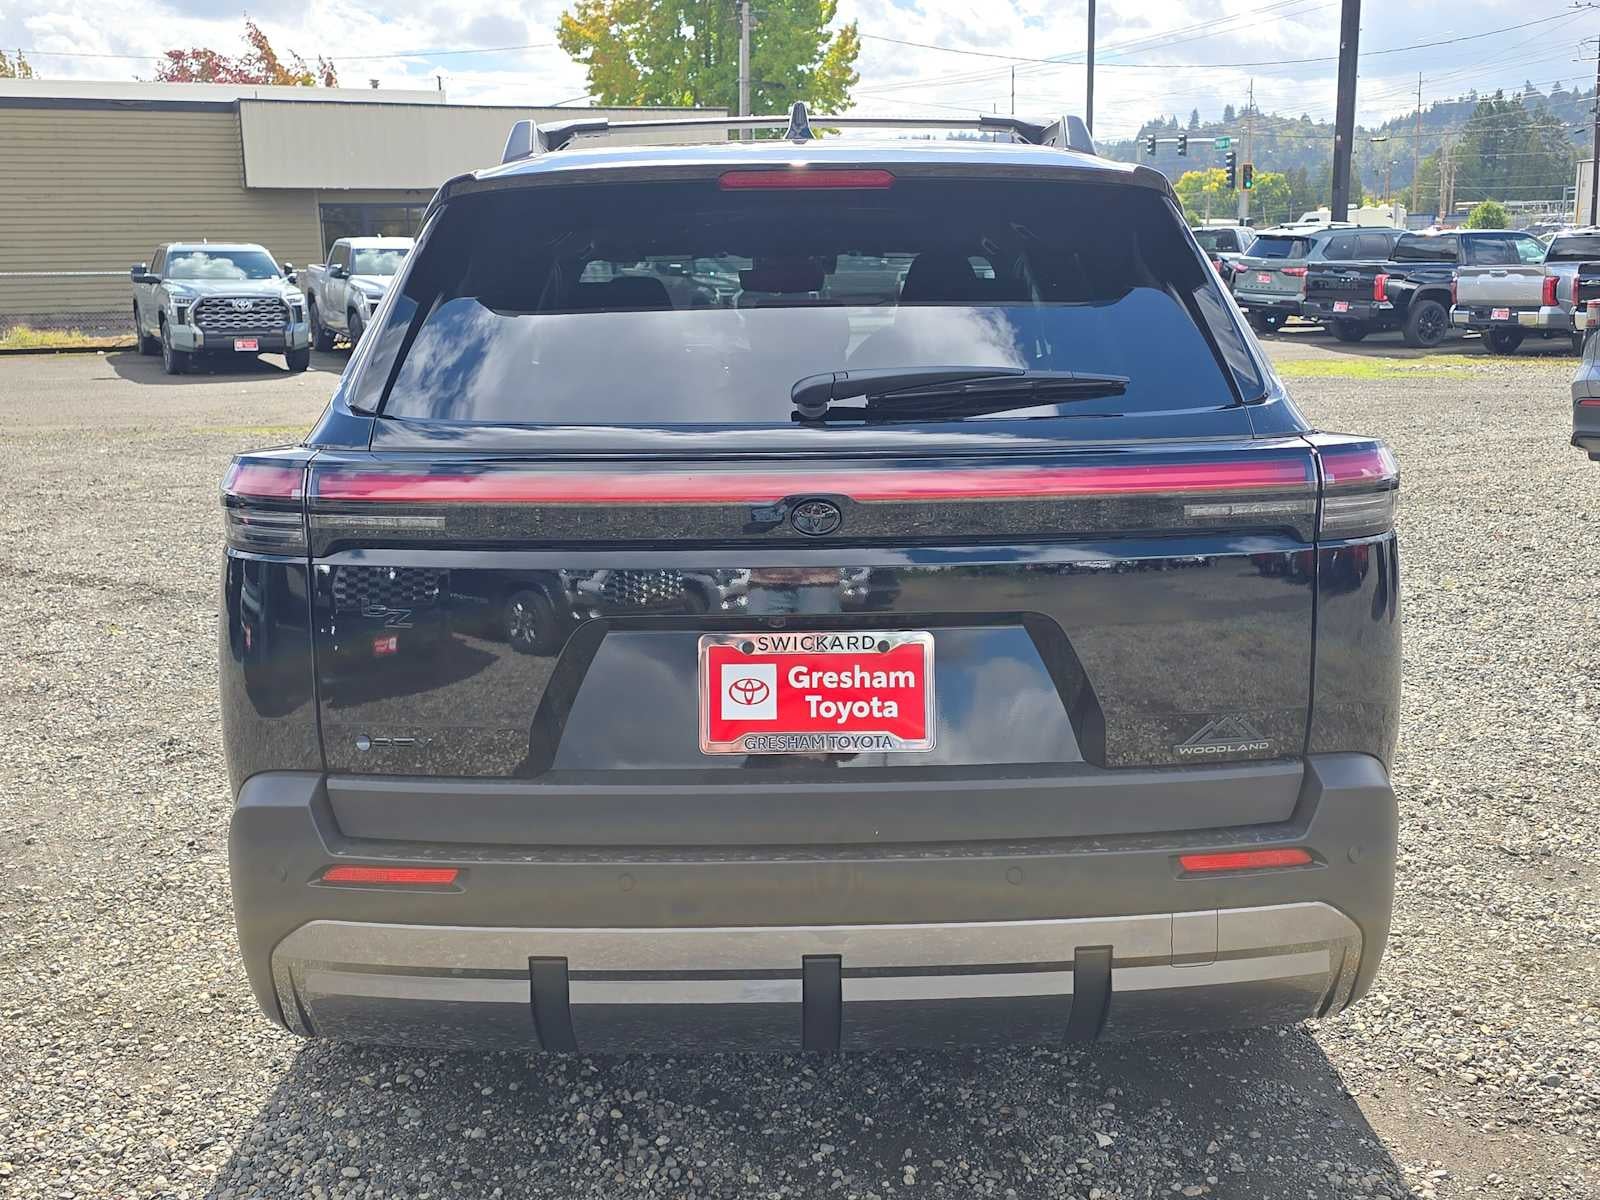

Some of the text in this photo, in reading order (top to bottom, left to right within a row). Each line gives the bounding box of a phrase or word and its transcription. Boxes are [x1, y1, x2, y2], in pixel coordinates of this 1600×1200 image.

[757, 635, 876, 652] SWICKARD
[788, 664, 915, 689] Gresham
[805, 695, 899, 724] Toyota
[744, 735, 893, 750] GRESHAM TOYOTA
[1179, 742, 1270, 755] WOODLAND
